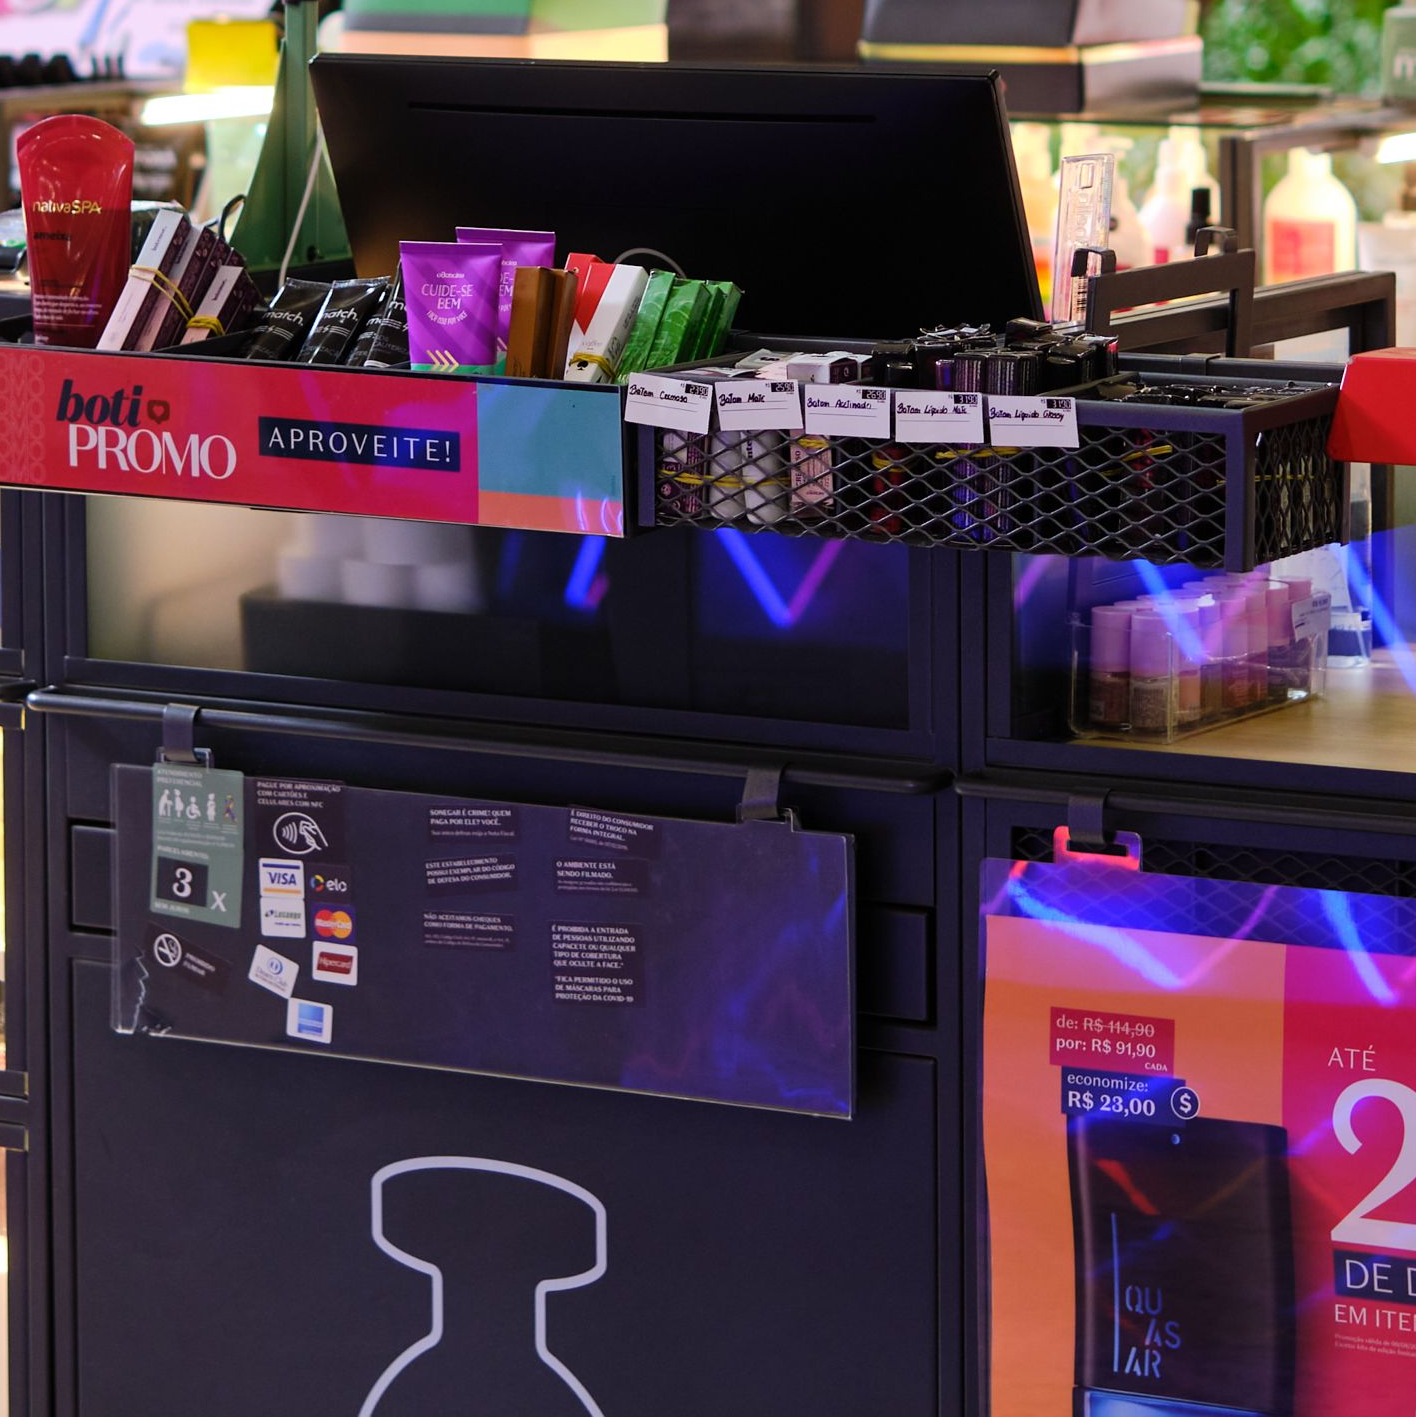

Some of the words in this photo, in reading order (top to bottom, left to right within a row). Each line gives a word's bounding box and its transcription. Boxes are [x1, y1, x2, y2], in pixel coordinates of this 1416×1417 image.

[421, 284, 474, 298] CUIDE-SE
[437, 297, 462, 310] BEM
[56, 379, 143, 428] boti
[69, 424, 237, 480] PROMO
[269, 426, 451, 464] APROVEITE!
[571, 818, 599, 828] RECEBER
[605, 824, 627, 834] TROCO
[576, 810, 602, 821] DIREITO
[613, 816, 654, 831] CONSUMIDOR
[569, 826, 592, 835] FORMA
[593, 830, 626, 841] INTEGRAL.
[441, 858, 498, 868] ESTABELECIMENTO
[599, 862, 616, 870] ESTÁ
[268, 872, 297, 885] VISA
[437, 876, 460, 884] DEFESA
[557, 870, 581, 878] SENDO
[581, 871, 614, 879] FILMADO.
[172, 868, 193, 898] 3
[211, 890, 227, 912] X
[326, 878, 347, 892] elo
[597, 927, 629, 935] ENTRADA
[553, 942, 587, 950] CAPACETE
[599, 944, 636, 952] QUALQUER
[581, 952, 622, 960] COBERTURA
[569, 960, 595, 968] OCULTE
[574, 976, 611, 984] PERMITIDO
[565, 984, 603, 992] MÁSCARAS
[555, 993, 592, 1001] PROTEÇÃO
[1056, 1015, 1079, 1031] de:
[1083, 1017, 1104, 1033] R$
[1108, 1020, 1155, 1038] 114,90
[1056, 1037, 1087, 1053] por:
[1091, 1038, 1111, 1055] R$
[1115, 1042, 1156, 1060] 91,90
[1328, 1044, 1377, 1072] ATÉ
[1145, 1062, 1168, 1072] CADA
[1067, 1072, 1149, 1093] economize:
[1067, 1090, 1094, 1112] R$
[1100, 1094, 1156, 1118] 23,00
[1345, 1259, 1393, 1294] DE
[1335, 1304, 1367, 1326] EM
